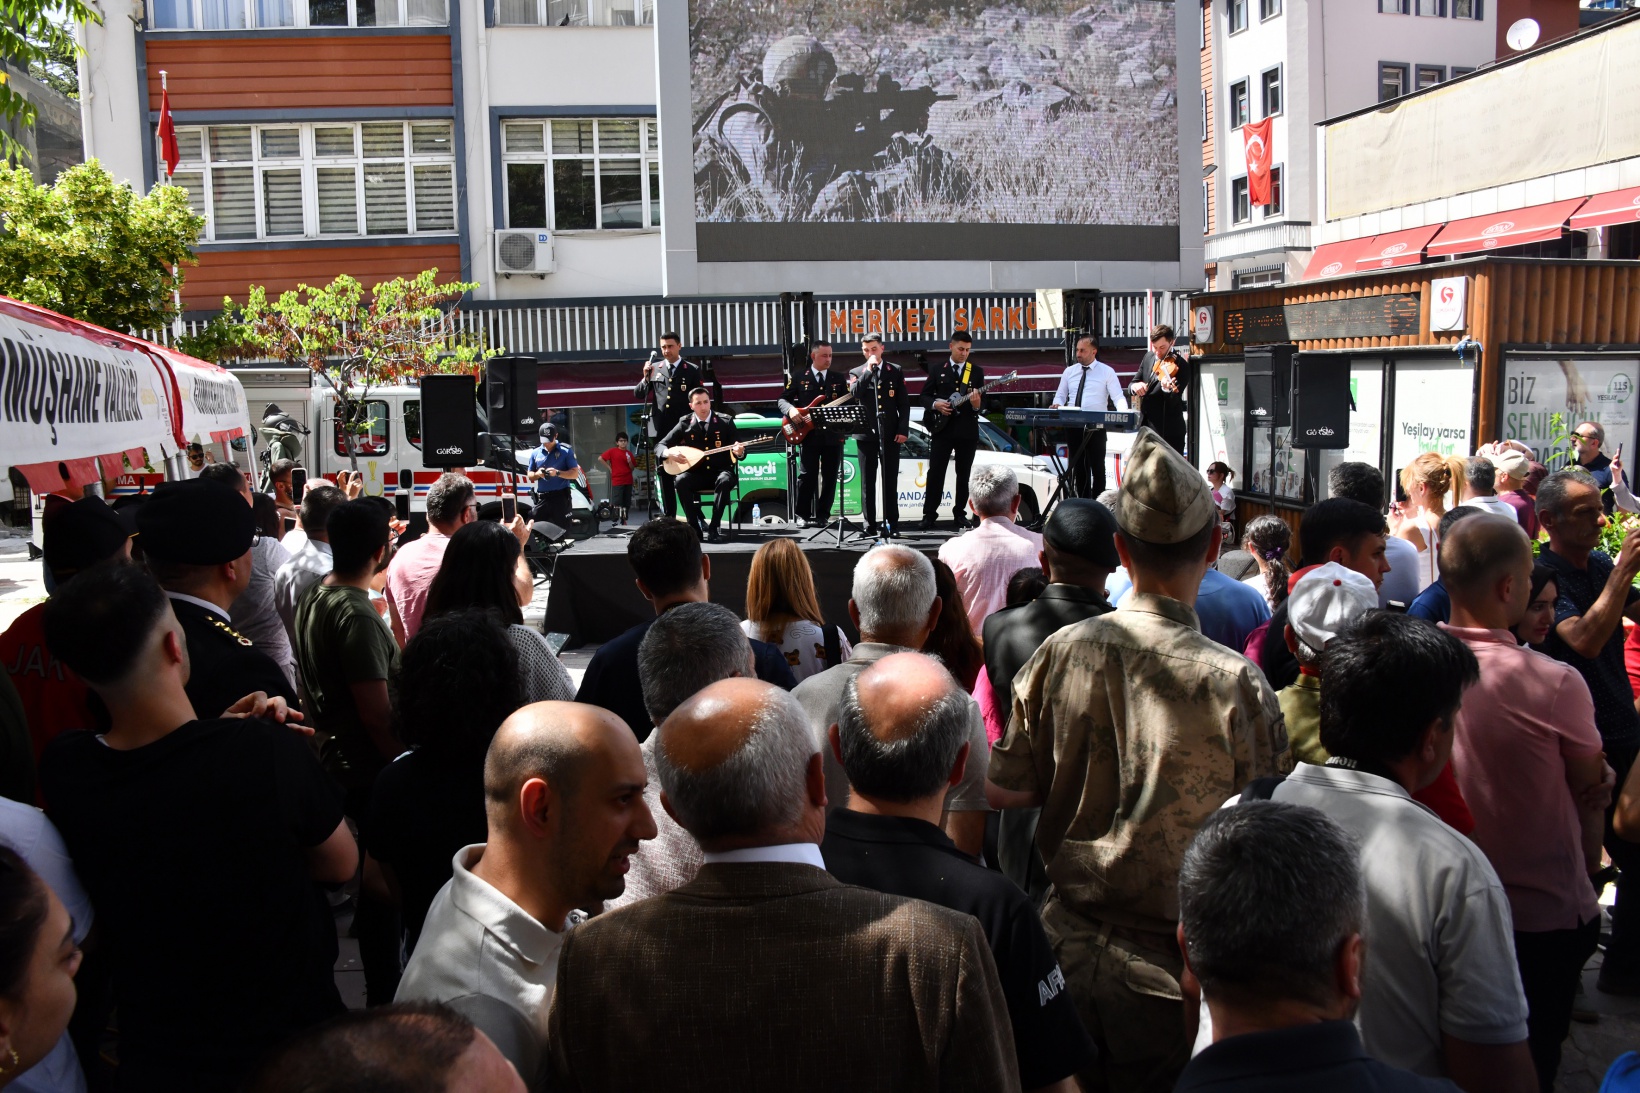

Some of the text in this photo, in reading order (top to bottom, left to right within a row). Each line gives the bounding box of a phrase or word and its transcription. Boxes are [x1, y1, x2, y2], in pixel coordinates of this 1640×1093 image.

[829, 307, 937, 334] MERKEZ
[0, 327, 101, 446] MÜŞHANE
[1507, 371, 1537, 405] BİZ
[1104, 413, 1128, 423] KORG
[1402, 422, 1466, 440] Yeşilay varsa
